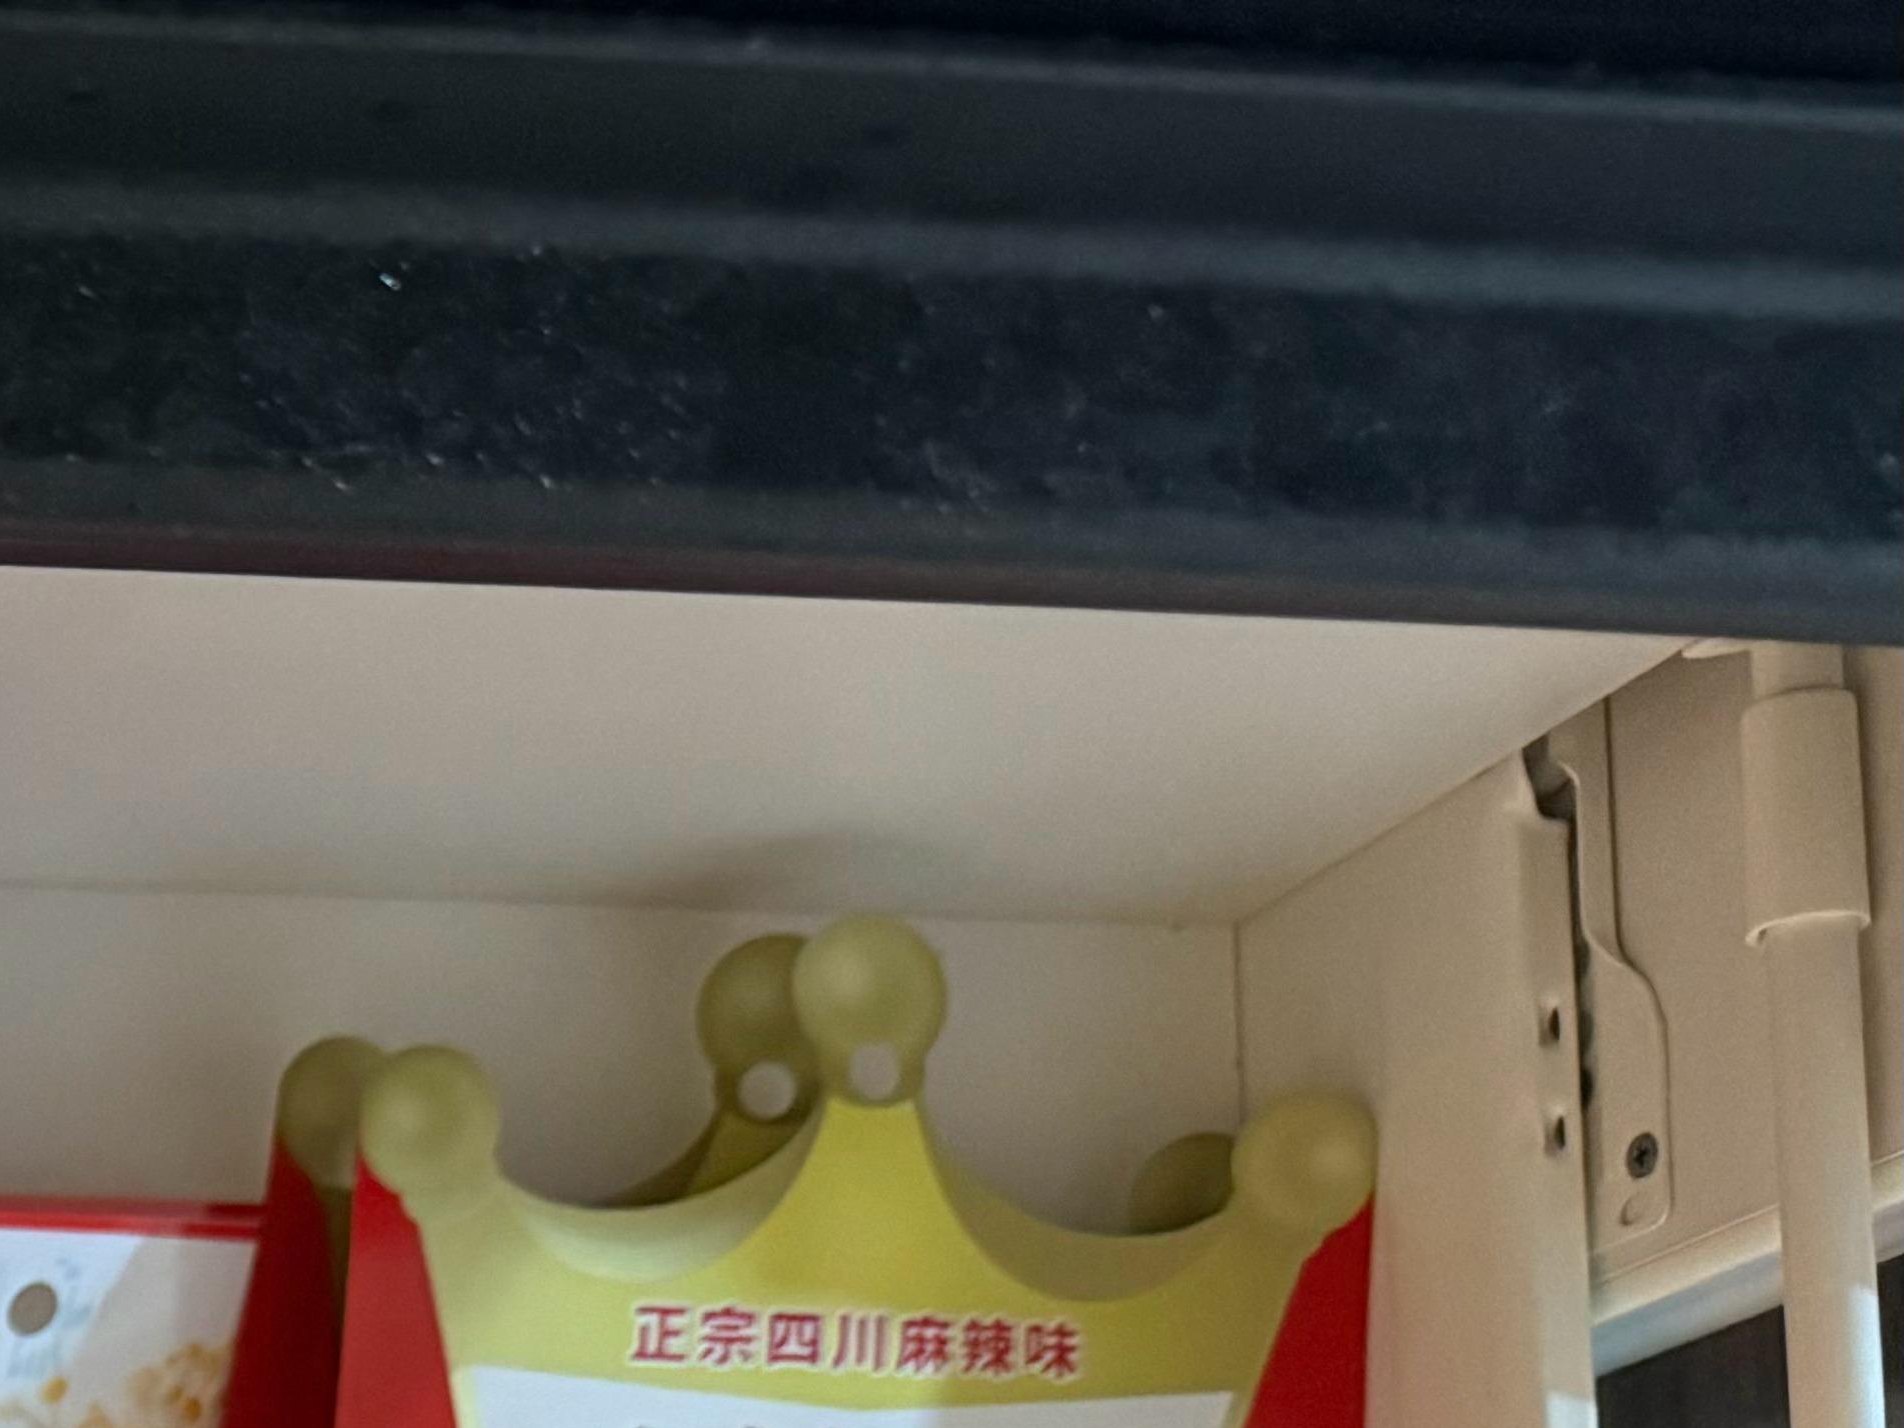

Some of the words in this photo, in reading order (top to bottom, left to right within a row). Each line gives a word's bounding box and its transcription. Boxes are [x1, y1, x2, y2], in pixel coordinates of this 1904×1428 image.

[631, 1302, 1082, 1381] 正宗四川麻辣味
